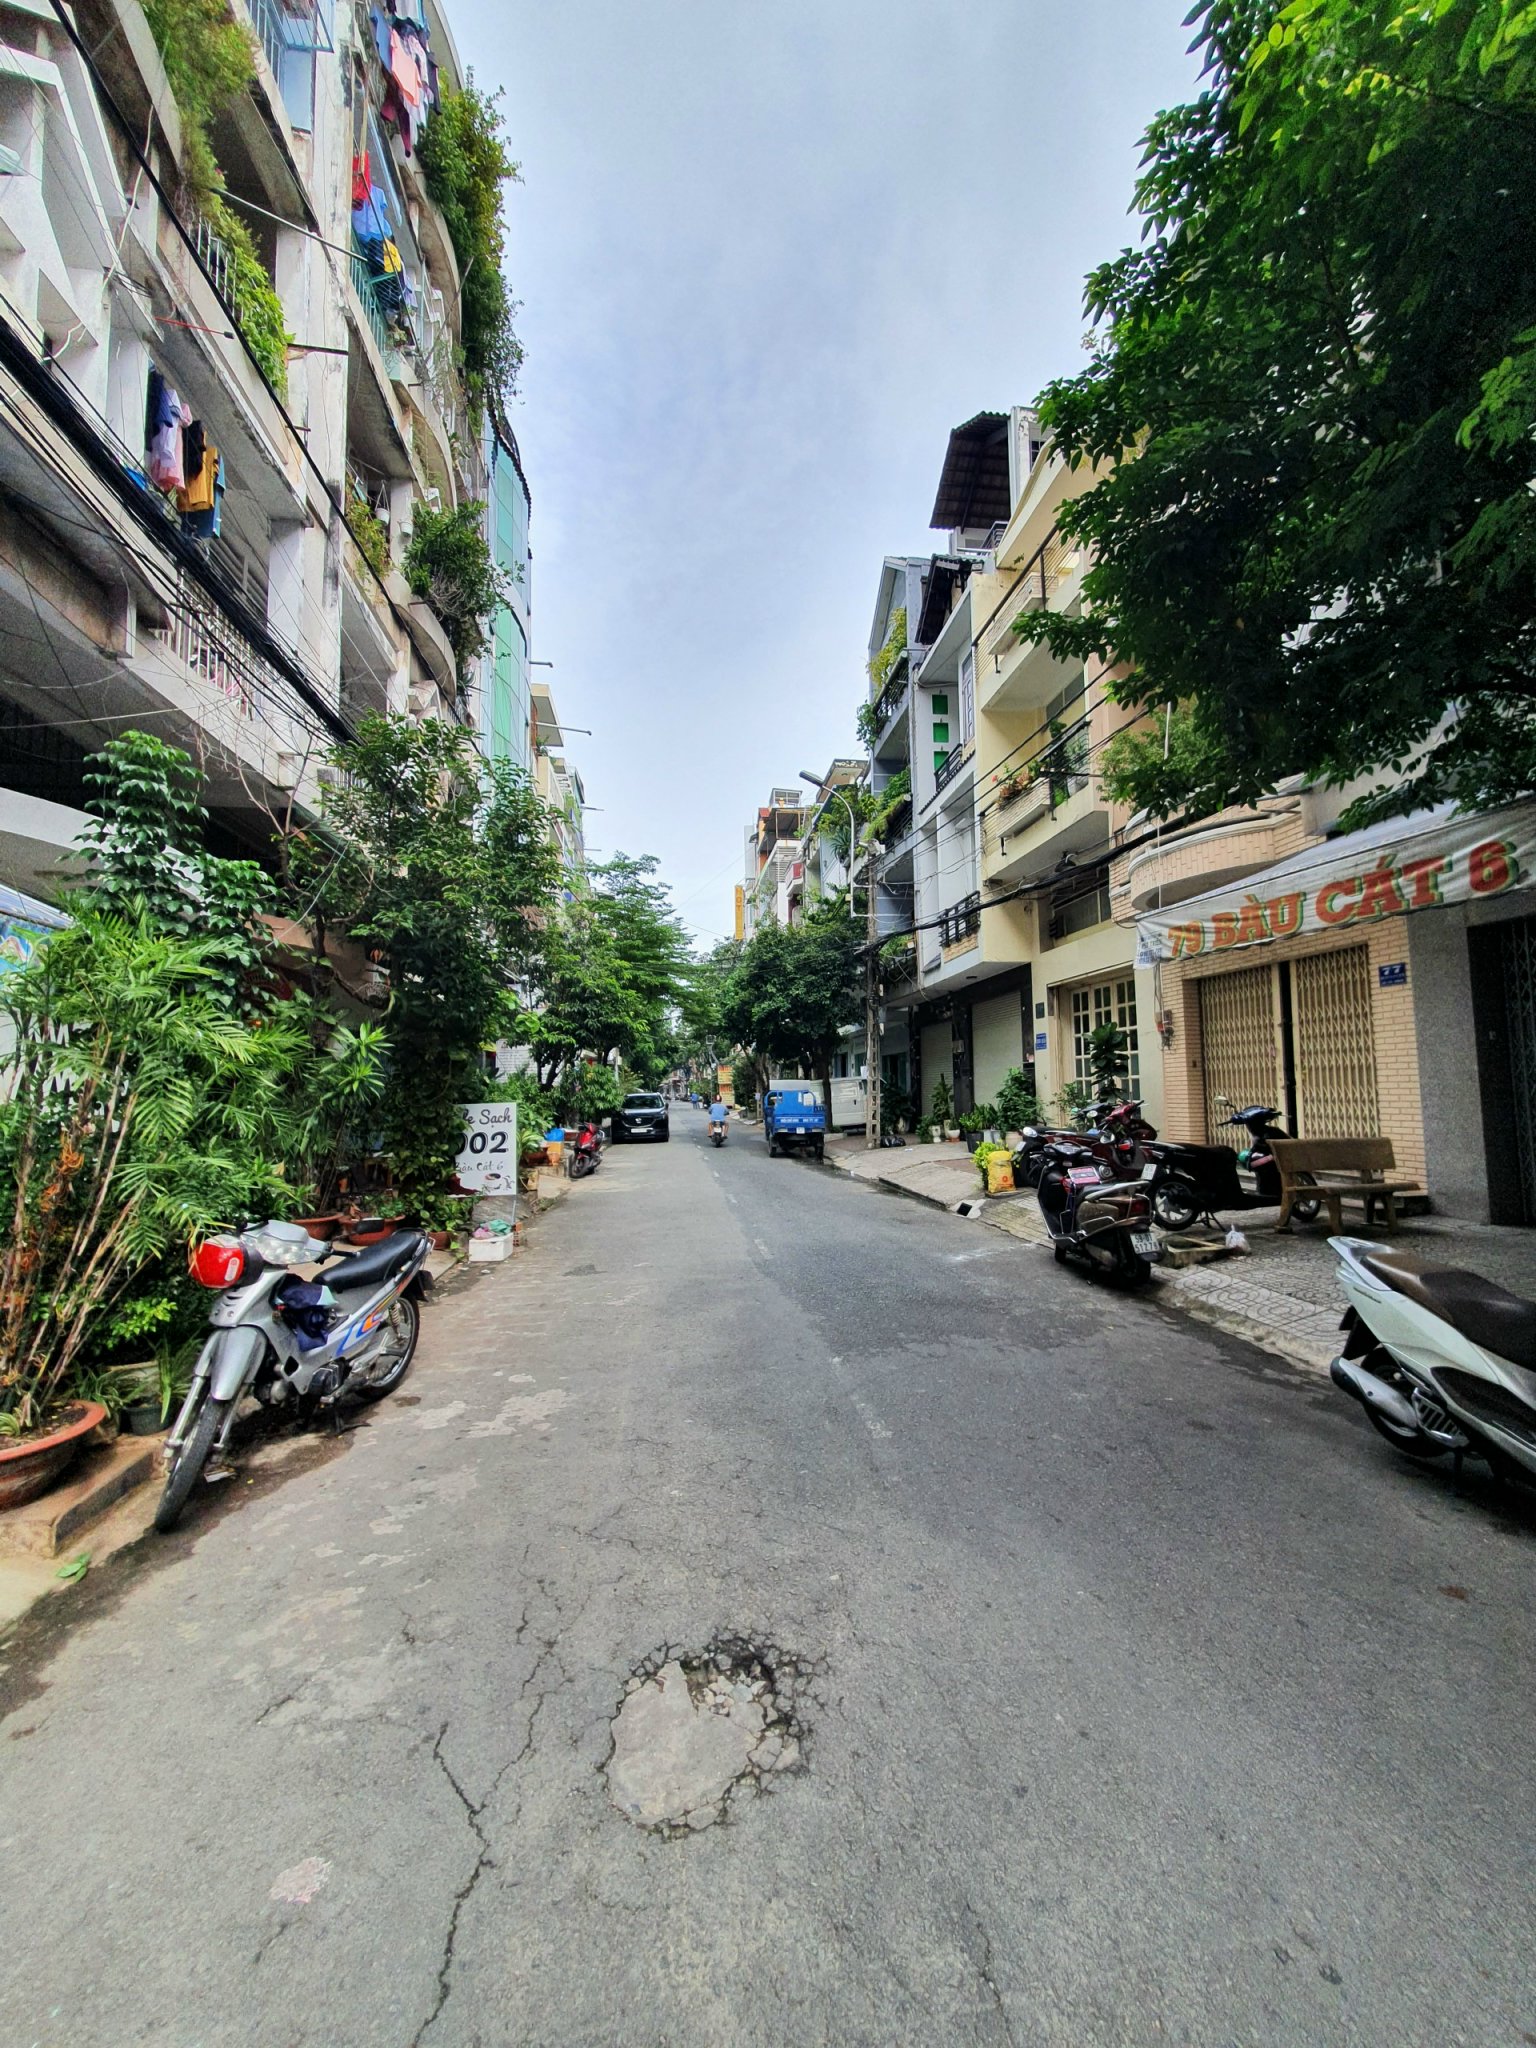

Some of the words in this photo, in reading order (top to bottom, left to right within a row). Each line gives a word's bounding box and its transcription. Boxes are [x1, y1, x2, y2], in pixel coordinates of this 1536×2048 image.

[1168, 919, 1206, 958] 79
[1212, 891, 1307, 951] BÀU
[1315, 853, 1453, 925] CÁT
[1468, 840, 1520, 892] 6
[1382, 965, 1401, 975] 77
